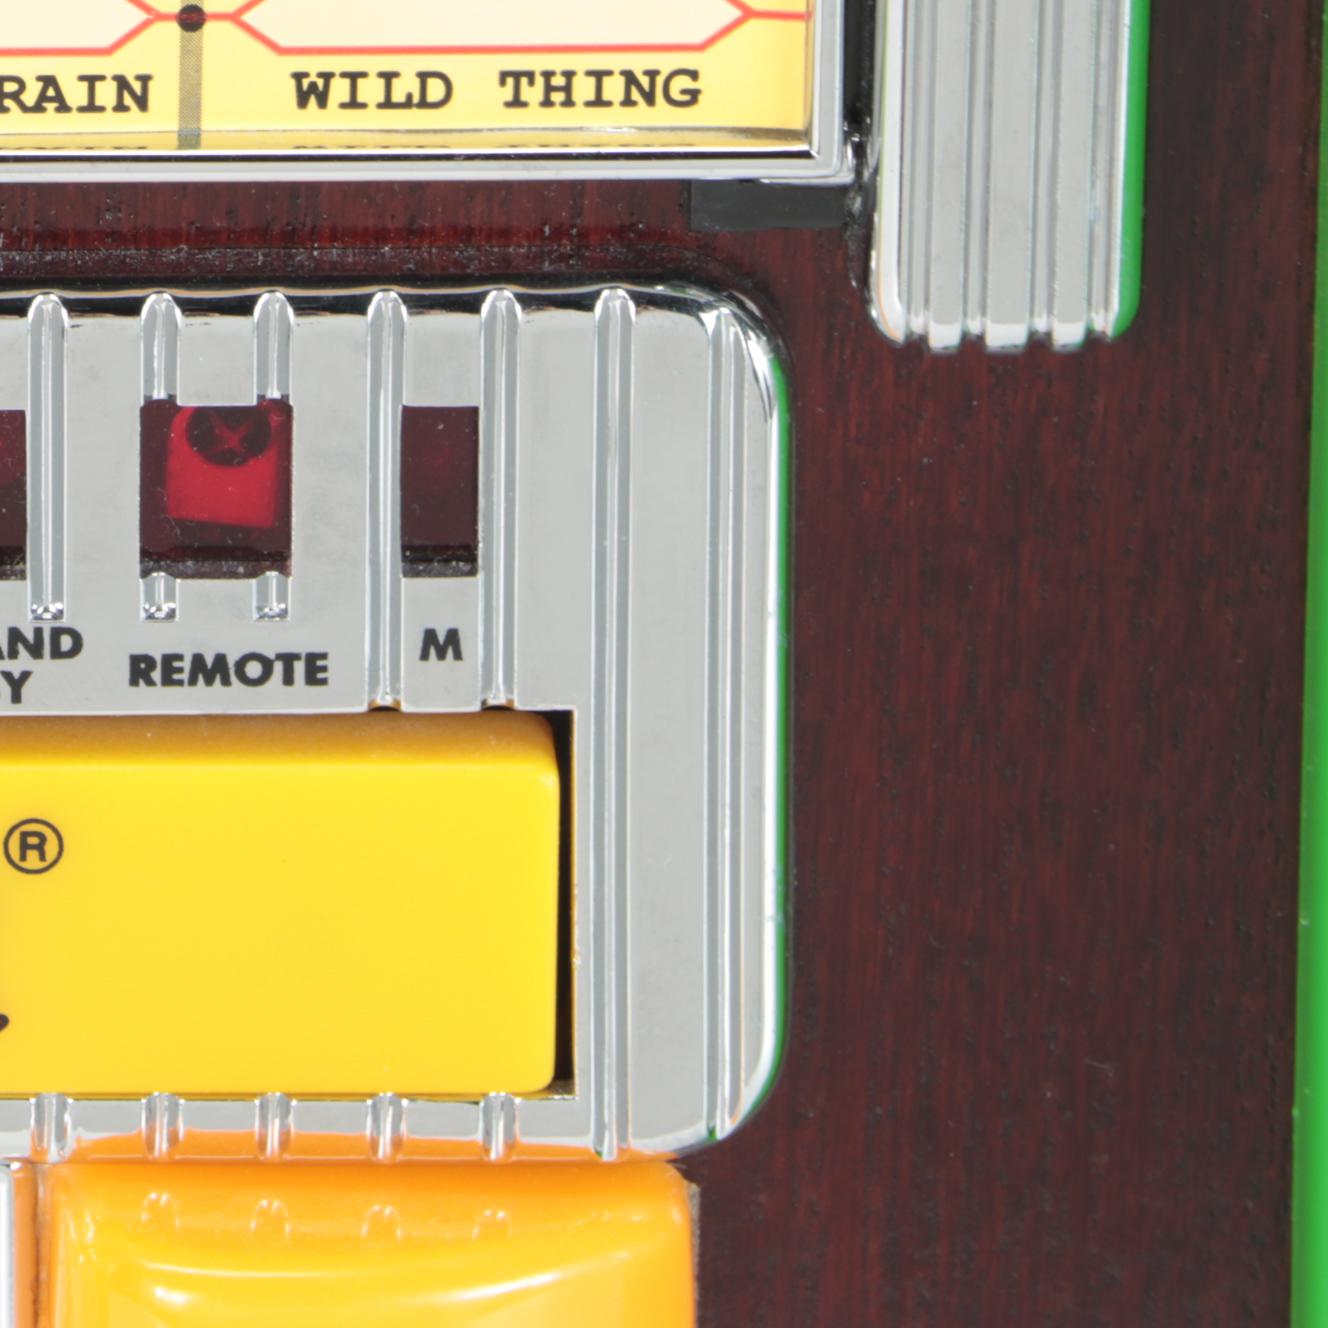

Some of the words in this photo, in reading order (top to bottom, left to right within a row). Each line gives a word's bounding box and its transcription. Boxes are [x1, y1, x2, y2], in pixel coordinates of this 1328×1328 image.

[291, 71, 452, 109] WILD
[500, 68, 701, 107] THING
[419, 627, 463, 662] M
[128, 651, 329, 688] REMOTE
